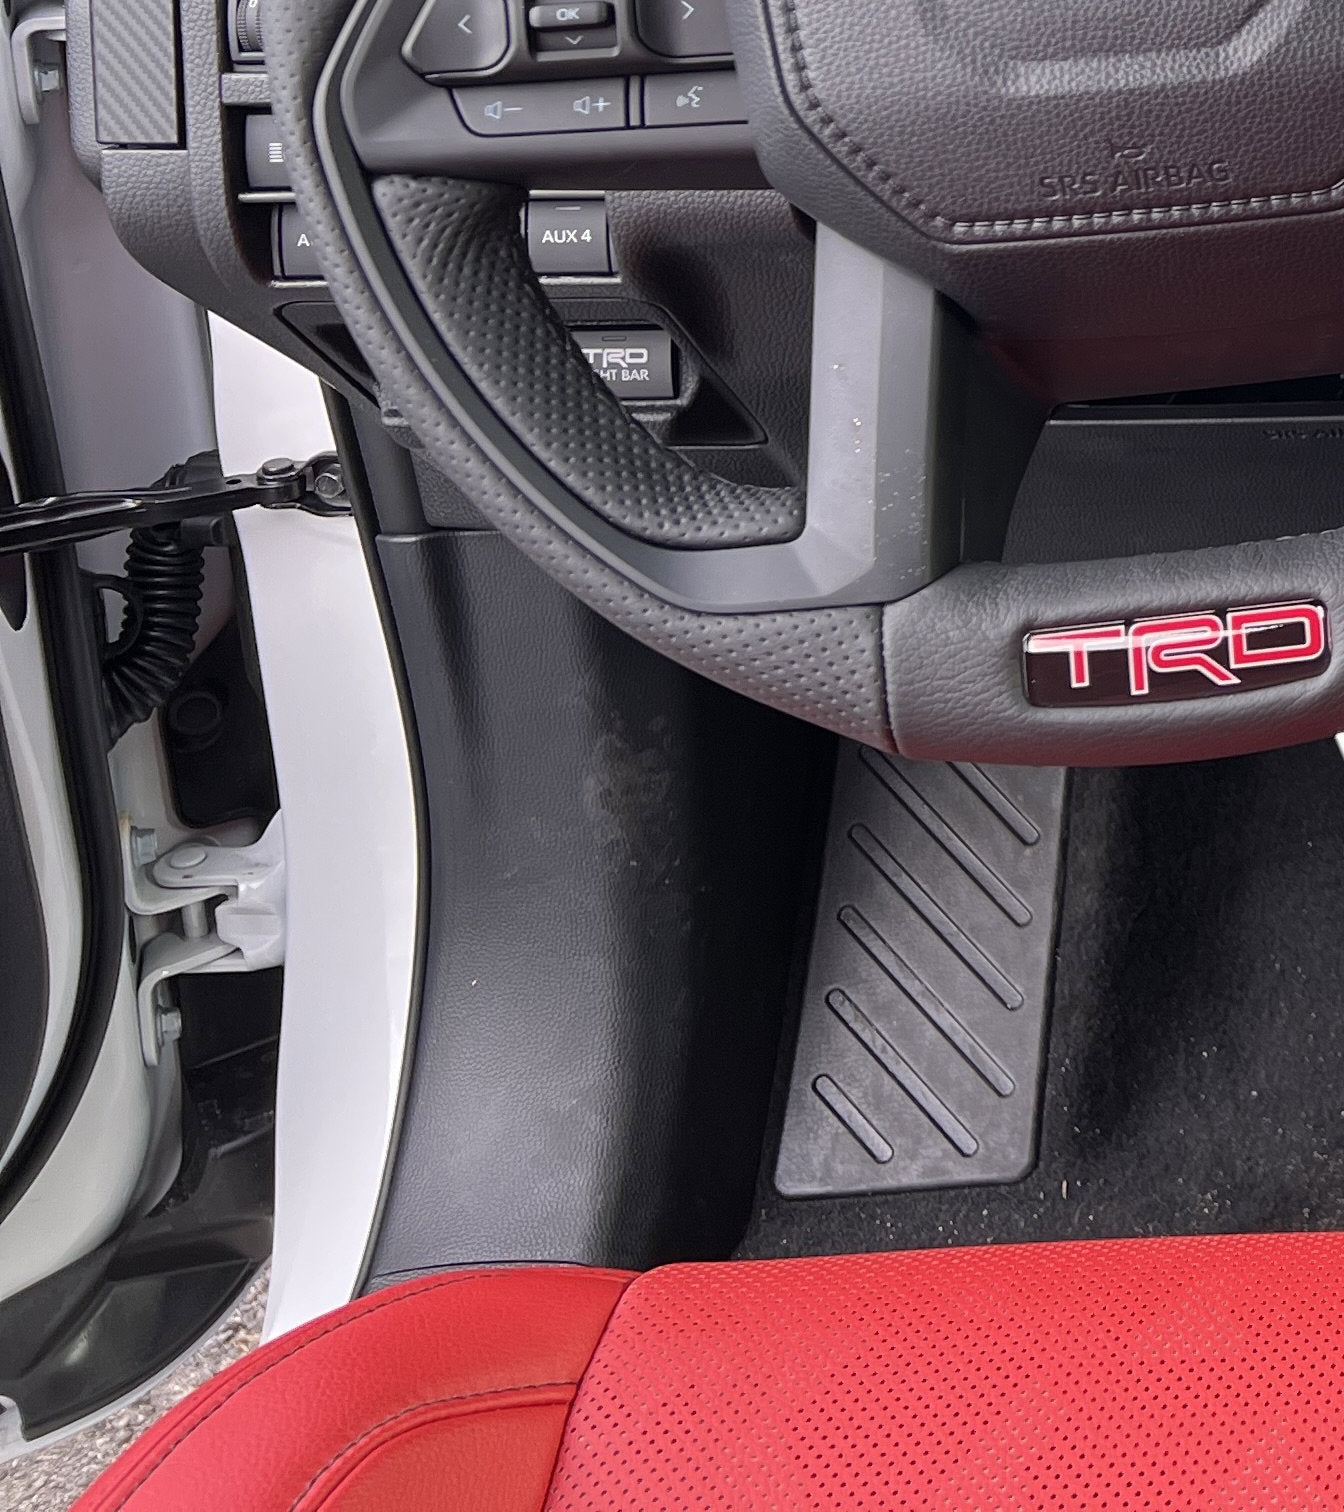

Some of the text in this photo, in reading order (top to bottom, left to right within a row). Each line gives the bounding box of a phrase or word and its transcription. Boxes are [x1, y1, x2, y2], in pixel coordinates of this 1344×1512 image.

[556, 7, 580, 21] OK
[1109, 159, 1233, 197] AIRBAG
[541, 229, 592, 244] AUX 4
[580, 348, 649, 368] TRD
[621, 368, 650, 381] BAR
[1027, 604, 1326, 696] TRD
